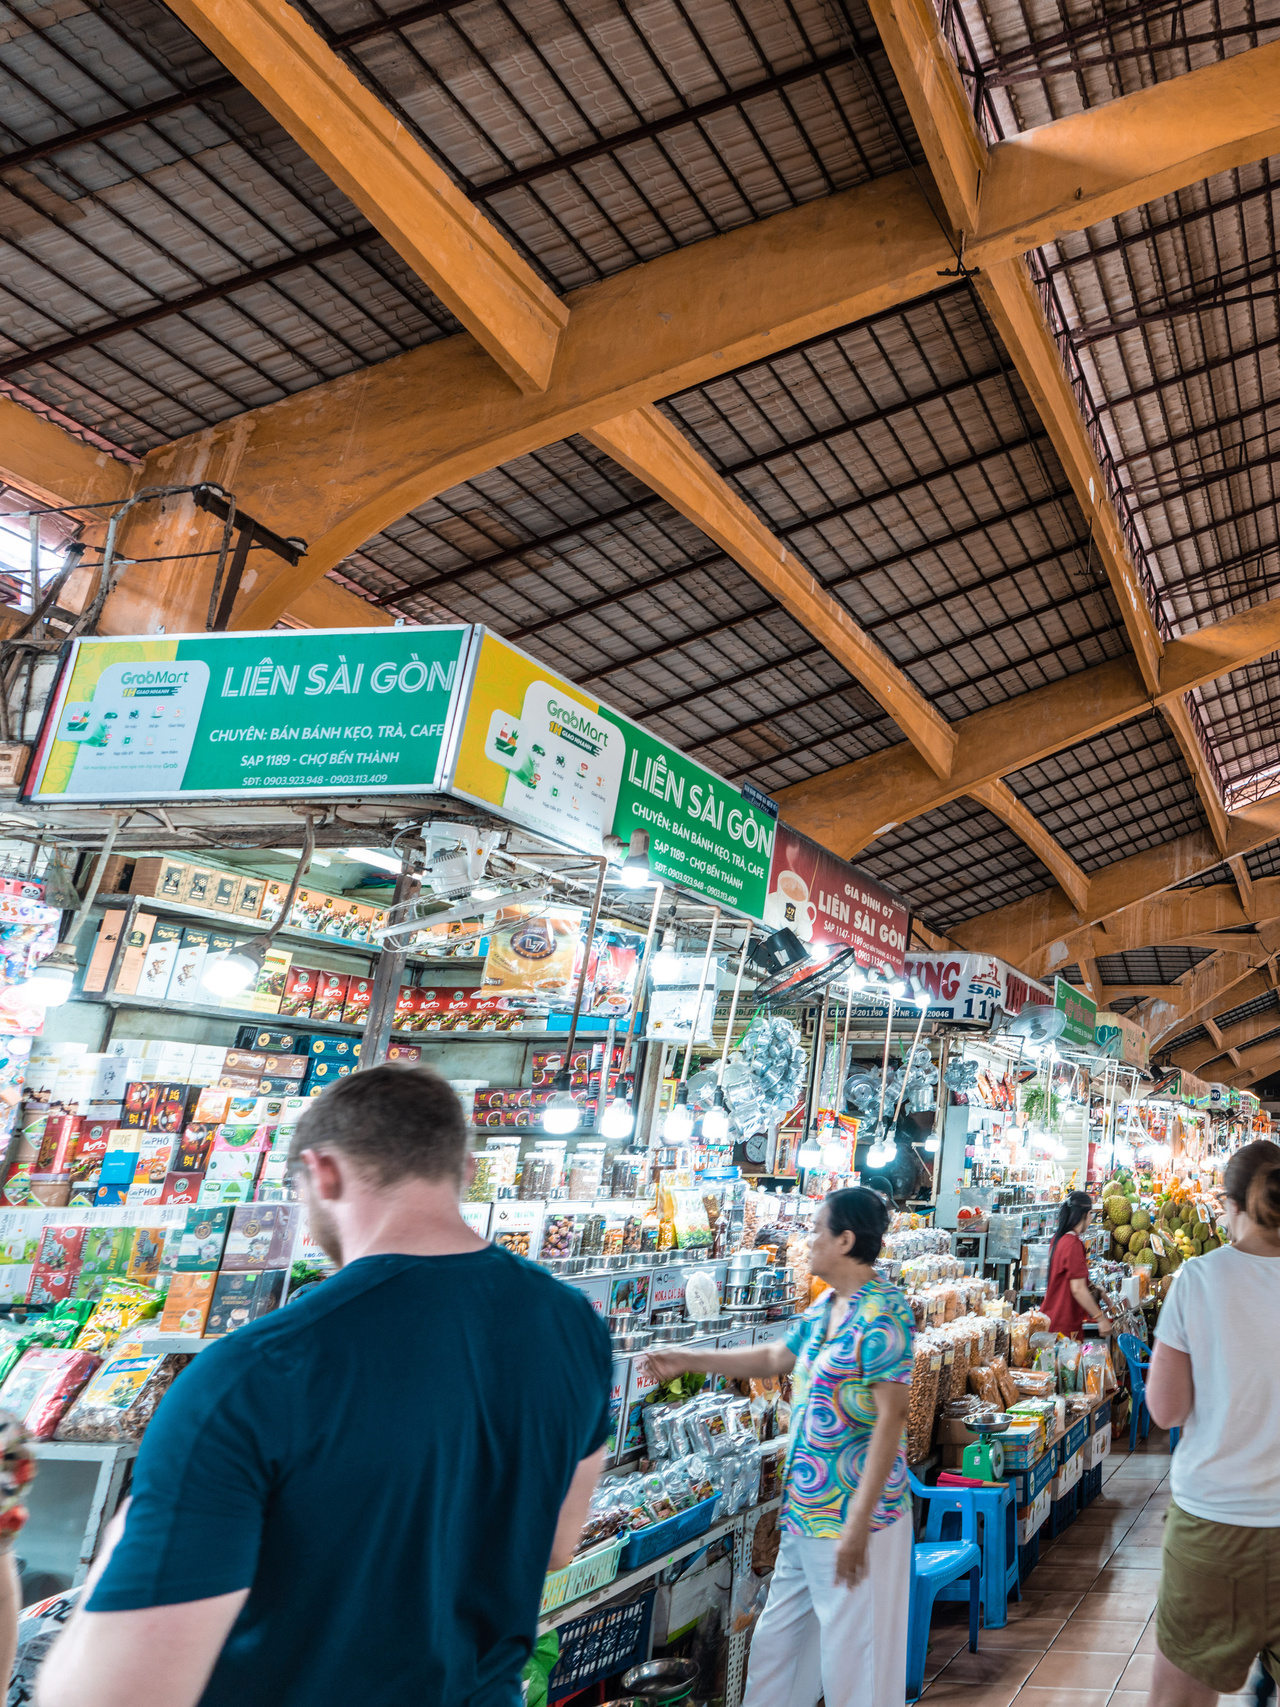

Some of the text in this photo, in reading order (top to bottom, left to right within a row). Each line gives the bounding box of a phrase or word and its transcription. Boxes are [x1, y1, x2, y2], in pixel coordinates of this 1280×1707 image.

[121, 671, 189, 685] GrabMart
[221, 653, 457, 697] LIÊN SÀI GÒN
[122, 688, 137, 697] 1H
[209, 722, 445, 742] CHUYÊN: BÁN BÁNH KẸO, TRÀ, CAFE
[547, 699, 609, 748] GrabMart
[549, 721, 593, 751] 1H GIAO NHANH
[240, 750, 399, 769] SẠP 1189 CHỢ BẾN THÀNH
[242, 774, 387, 786] SĐT: 0903.923.948 0903.113.409
[628, 748, 686, 810] LIÊN
[687, 784, 725, 832] SÀI
[727, 809, 774, 859] GÒN
[631, 802, 765, 879] CHUYÊN: BÁN BÁNH KẸO, TRÀ, CAFE
[653, 839, 743, 890] SẠP 1189 CHỢ BẾN THÀNH
[654, 861, 738, 906] SĐT: 0903.923.948 0903.113.409
[844, 883, 860, 902] GIA
[862, 893, 881, 914] ĐÌNH
[882, 905, 894, 919] G7
[818, 890, 906, 953] LIÊN SÀI GÒN
[823, 920, 835, 934] SẠP
[851, 932, 864, 946] 1189
[857, 949, 871, 963] 0903
[968, 983, 1002, 999] SẠP
